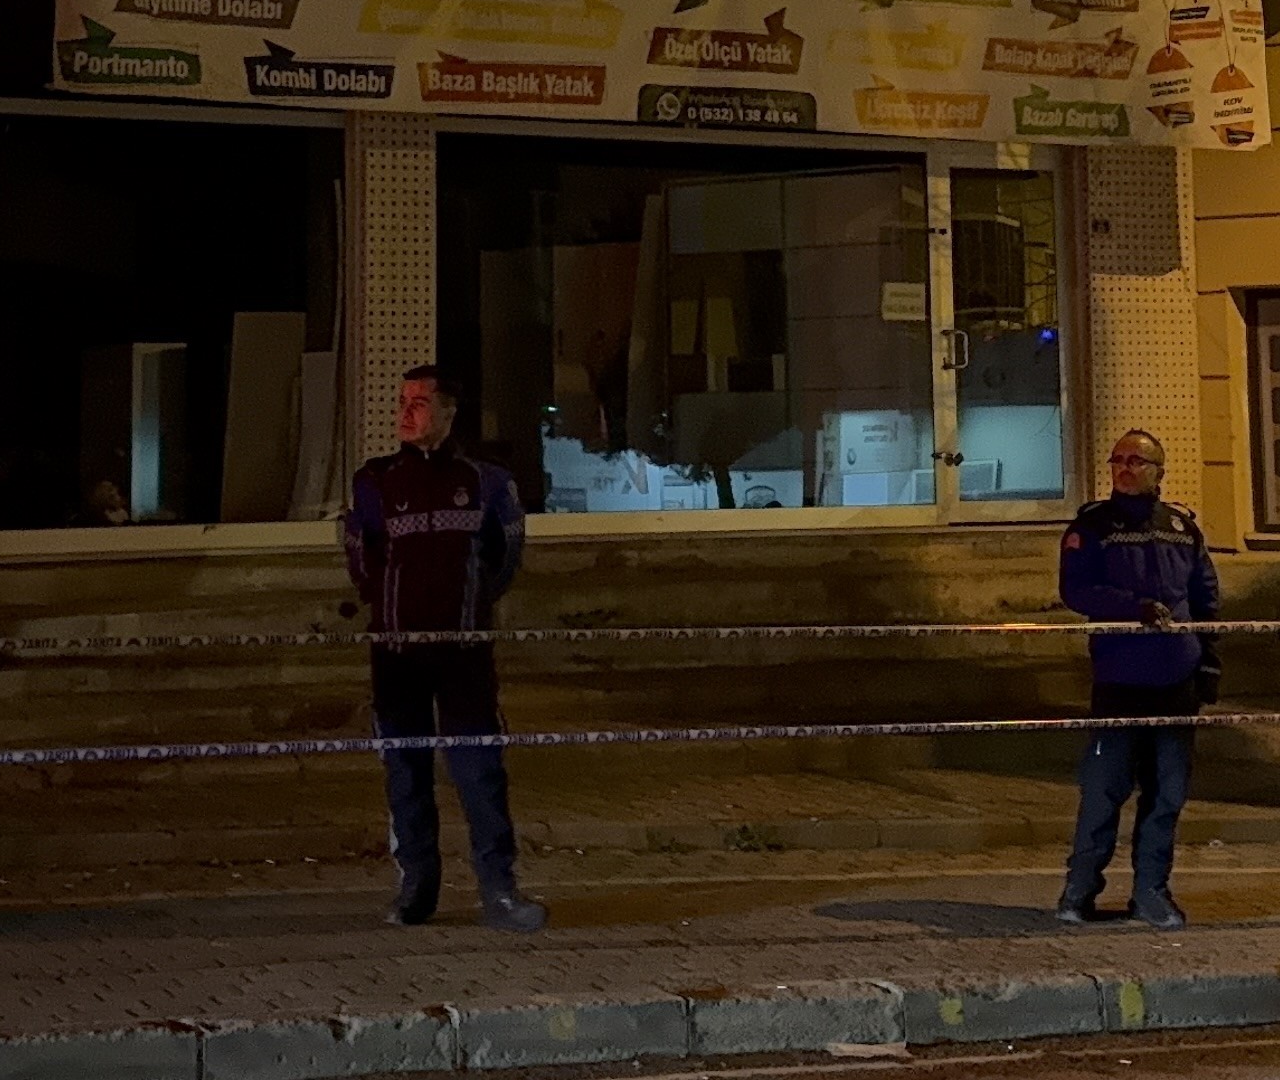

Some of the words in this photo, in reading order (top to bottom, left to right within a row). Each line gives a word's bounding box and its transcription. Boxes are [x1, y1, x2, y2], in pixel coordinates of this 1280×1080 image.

[665, 33, 698, 60] Özel
[746, 42, 793, 65] Yatak
[73, 51, 189, 79] Portmanto
[256, 64, 317, 90] Kombi
[323, 68, 386, 93] Dolabı
[427, 69, 476, 92] Baza
[482, 71, 541, 98] Başlık
[544, 74, 594, 98] Yatak
[687, 107, 696, 119] 0
